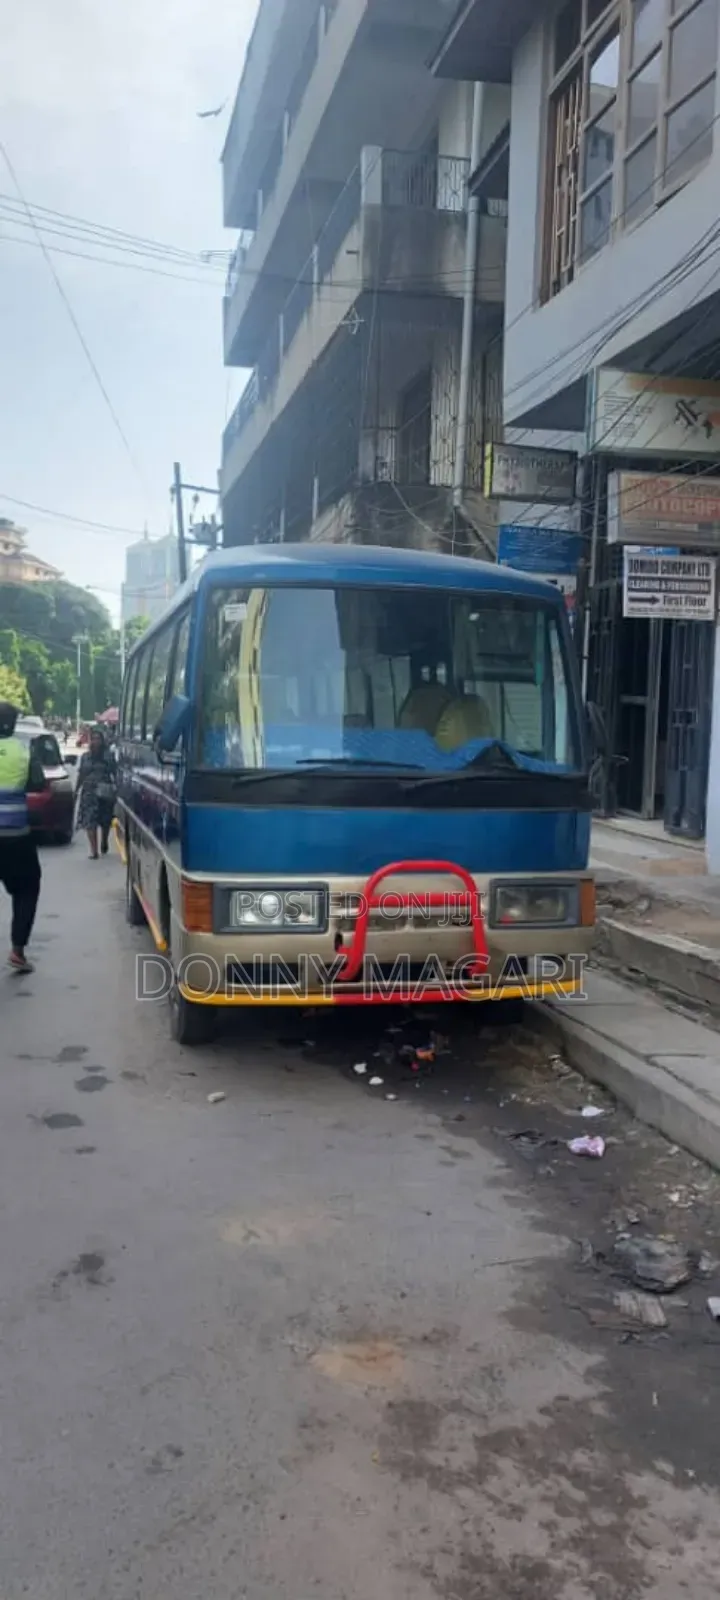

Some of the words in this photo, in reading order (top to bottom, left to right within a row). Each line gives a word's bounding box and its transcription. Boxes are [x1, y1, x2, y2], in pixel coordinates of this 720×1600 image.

[661, 560, 696, 575] COMPANY
[698, 562, 711, 577] LTD
[663, 595, 682, 606] First
[684, 595, 707, 608] Floor
